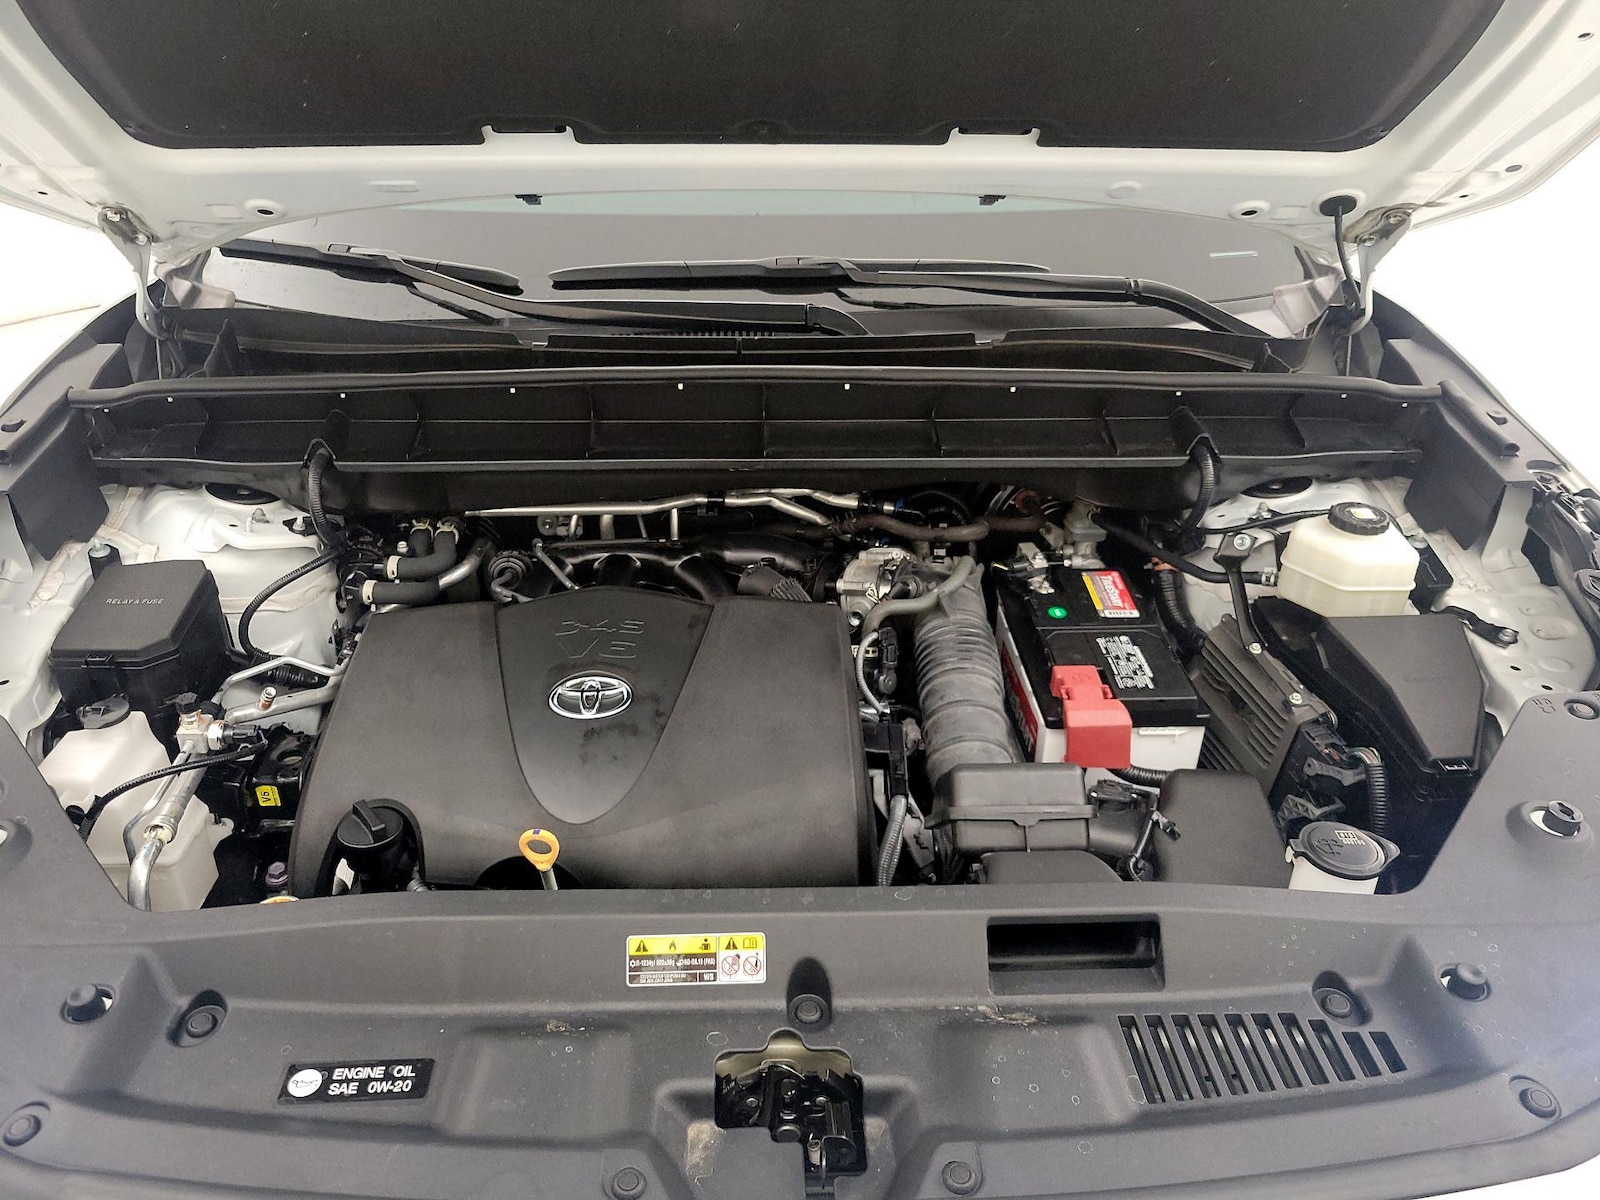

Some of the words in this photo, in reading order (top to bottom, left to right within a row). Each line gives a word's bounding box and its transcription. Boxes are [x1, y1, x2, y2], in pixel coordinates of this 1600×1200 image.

[332, 1066, 386, 1080] ENGINE
[393, 1065, 416, 1077] OIL
[327, 1082, 359, 1096] SAE
[367, 1080, 412, 1094] 0W-20
